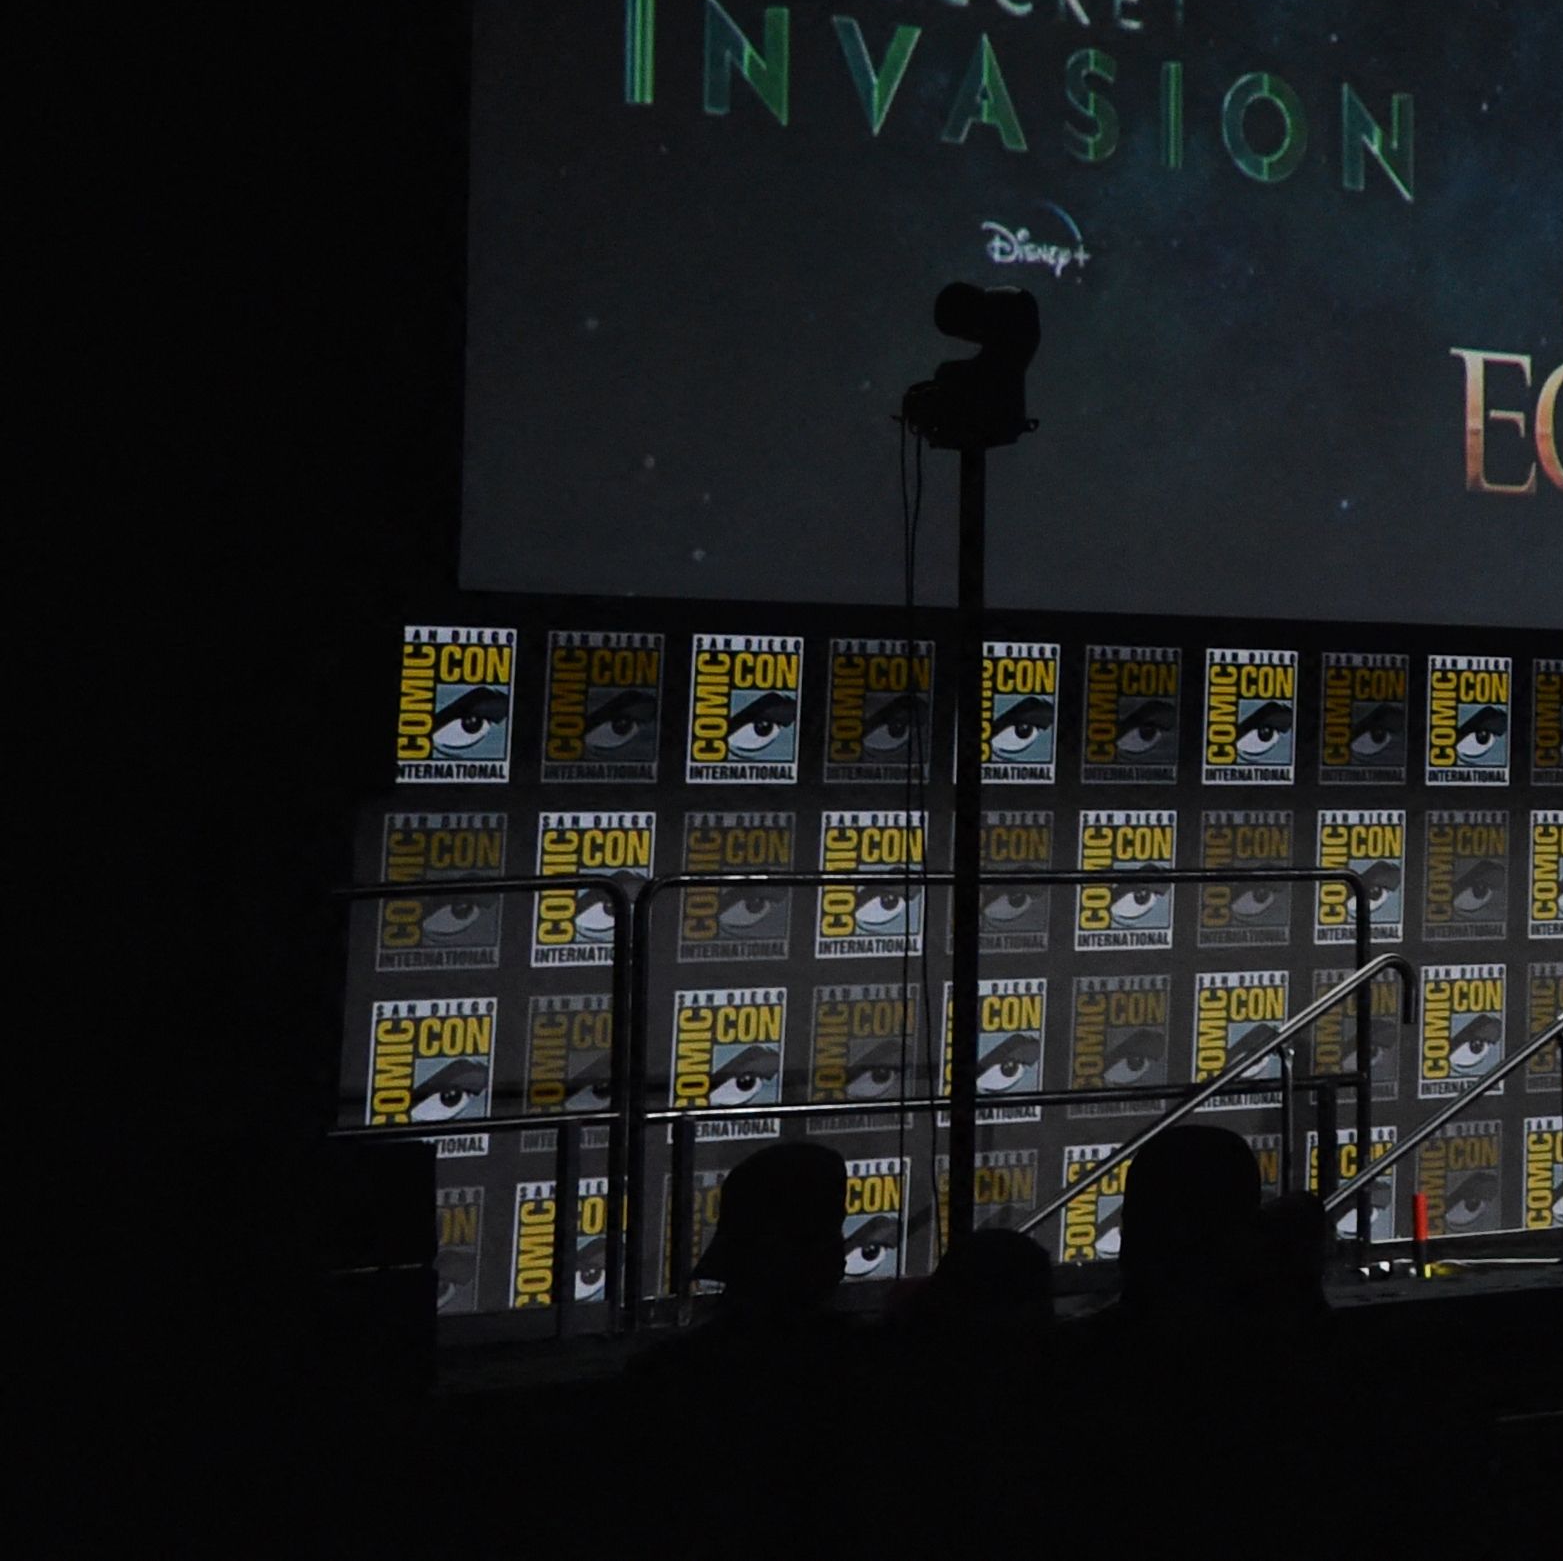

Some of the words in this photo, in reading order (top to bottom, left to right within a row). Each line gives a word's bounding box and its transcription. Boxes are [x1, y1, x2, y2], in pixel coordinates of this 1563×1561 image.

[451, 629, 515, 645] DIEGO
[695, 639, 735, 652] SAN
[745, 640, 800, 654] DIEGO
[440, 645, 511, 683] CON
[734, 652, 799, 688] CON
[1208, 652, 1241, 664] SAN
[1249, 654, 1296, 666] DIEGO
[1240, 665, 1294, 698] CON
[1459, 671, 1509, 703] CON
[397, 644, 436, 759] COMIC
[692, 652, 731, 761] COMIC
[1207, 665, 1238, 764] COMIC
[1430, 671, 1457, 767] COMIC
[689, 766, 794, 780] INTERNATIONAL
[1205, 769, 1292, 782] INTERNATIONAL
[1533, 826, 1561, 919] COMIC
[376, 1001, 416, 1018] SAN
[430, 999, 495, 1016] DIEGO
[417, 1016, 491, 1057] CON
